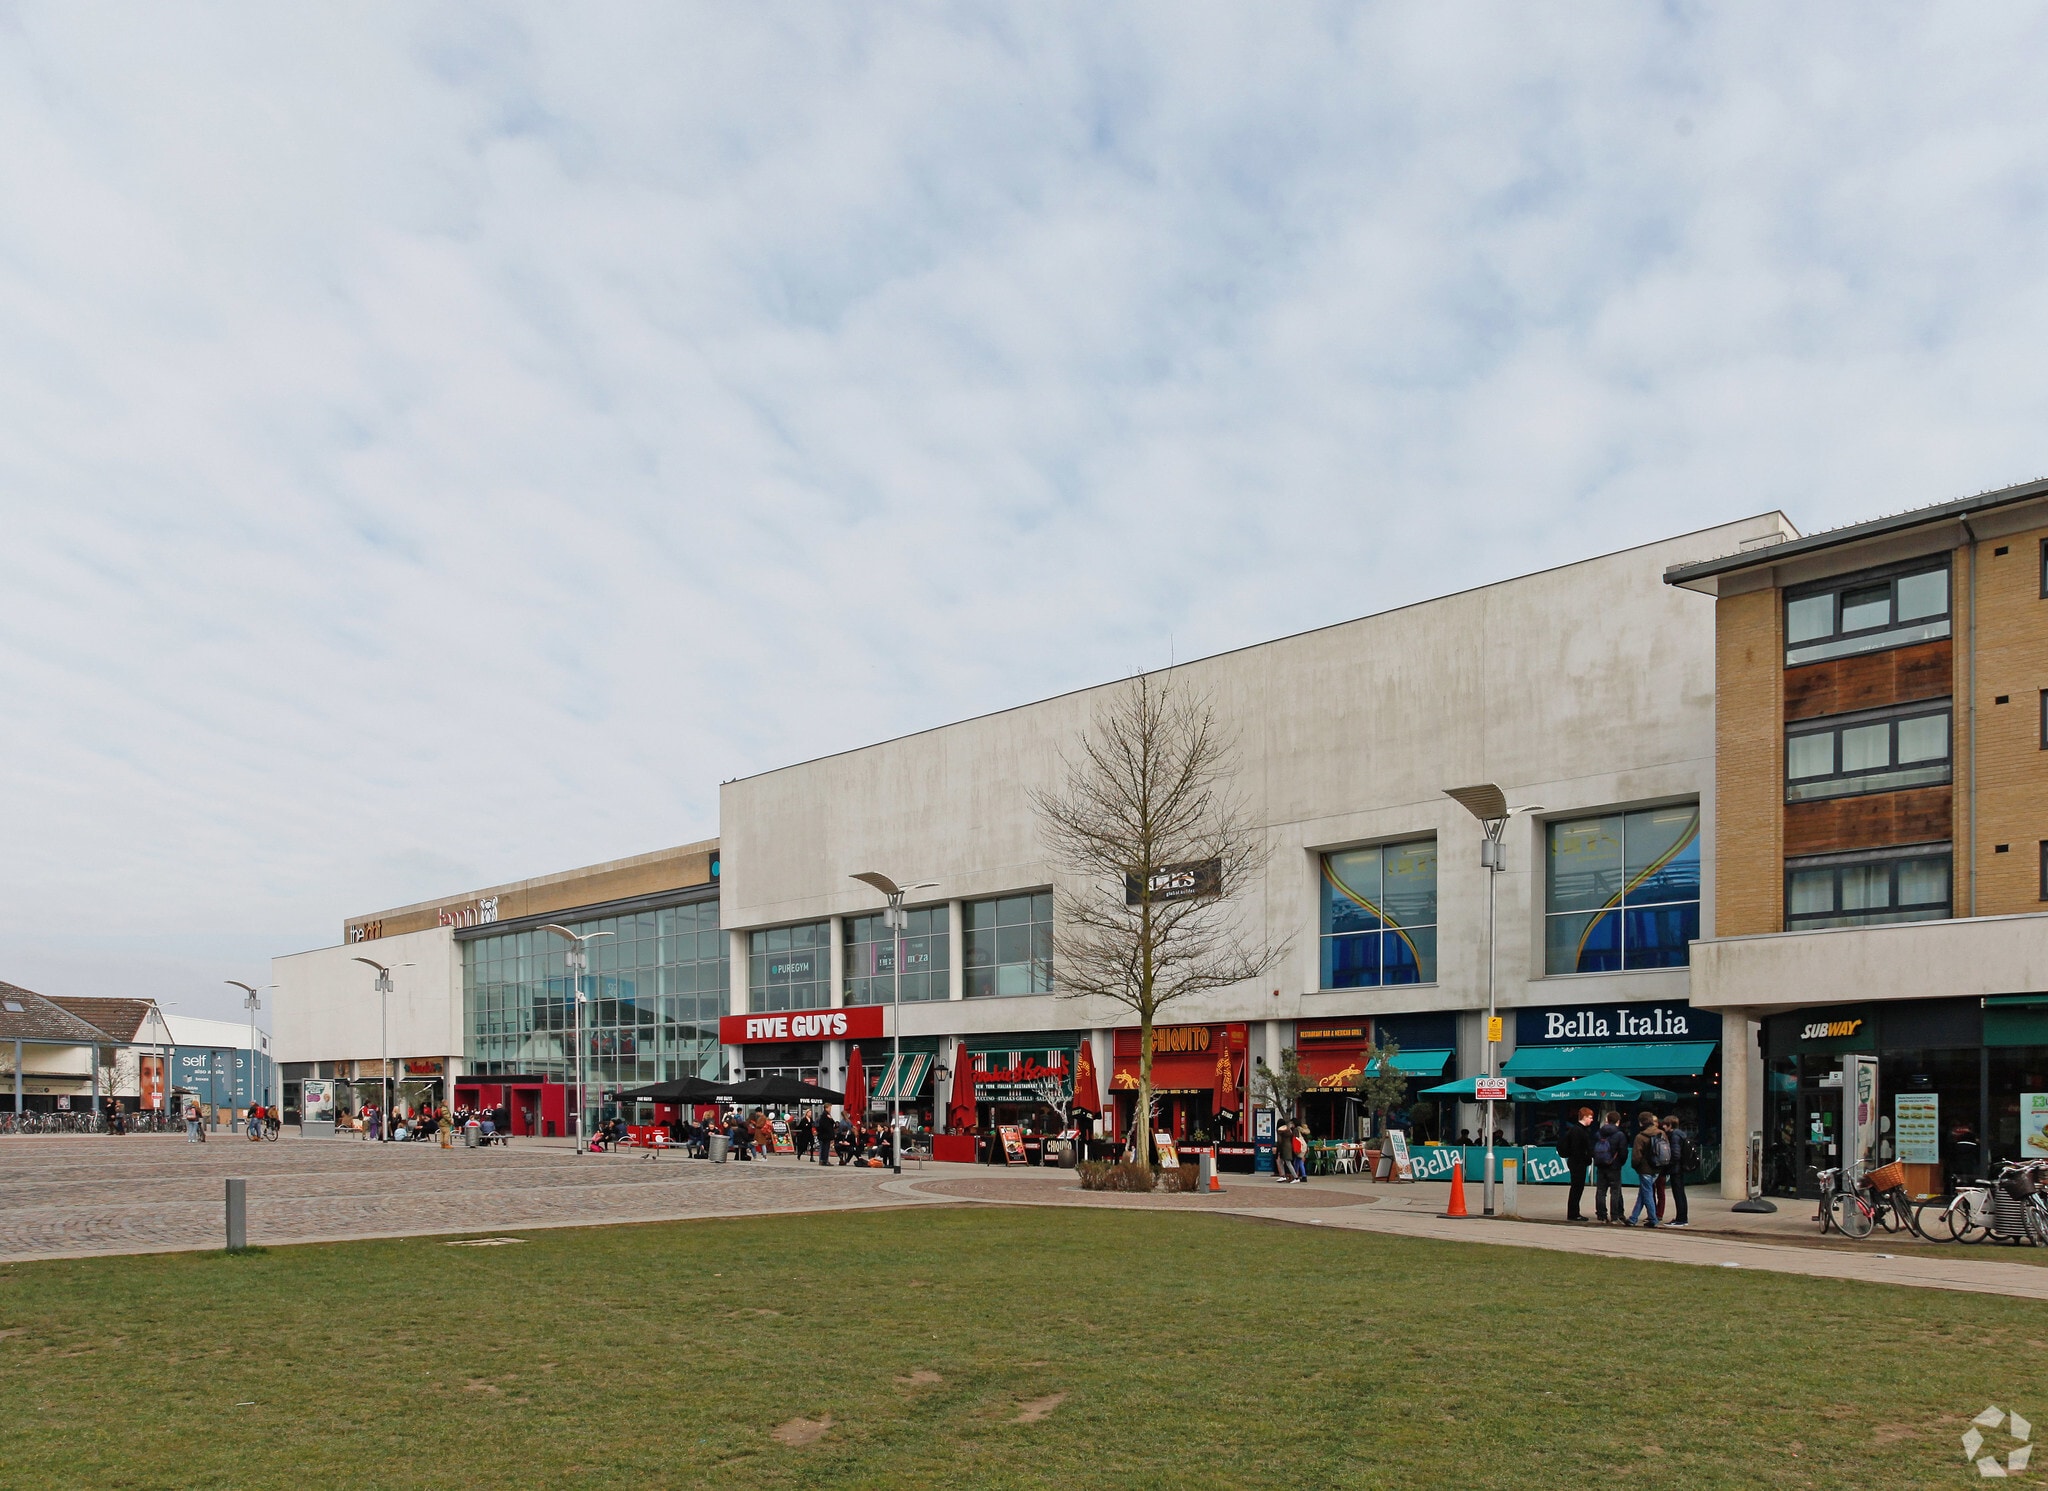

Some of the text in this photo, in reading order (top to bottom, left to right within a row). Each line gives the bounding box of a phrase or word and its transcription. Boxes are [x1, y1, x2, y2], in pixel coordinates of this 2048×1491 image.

[350, 925, 364, 943] the
[778, 962, 809, 973] PUREGYM
[747, 1013, 848, 1039] FIVE GUYS
[1544, 1008, 1688, 1038] Bella Italia
[1800, 1019, 1862, 1040] SUBWAY
[1151, 1026, 1211, 1052] CHIQUITO
[182, 1055, 206, 1067] self
[1410, 1149, 1463, 1178] Bella
